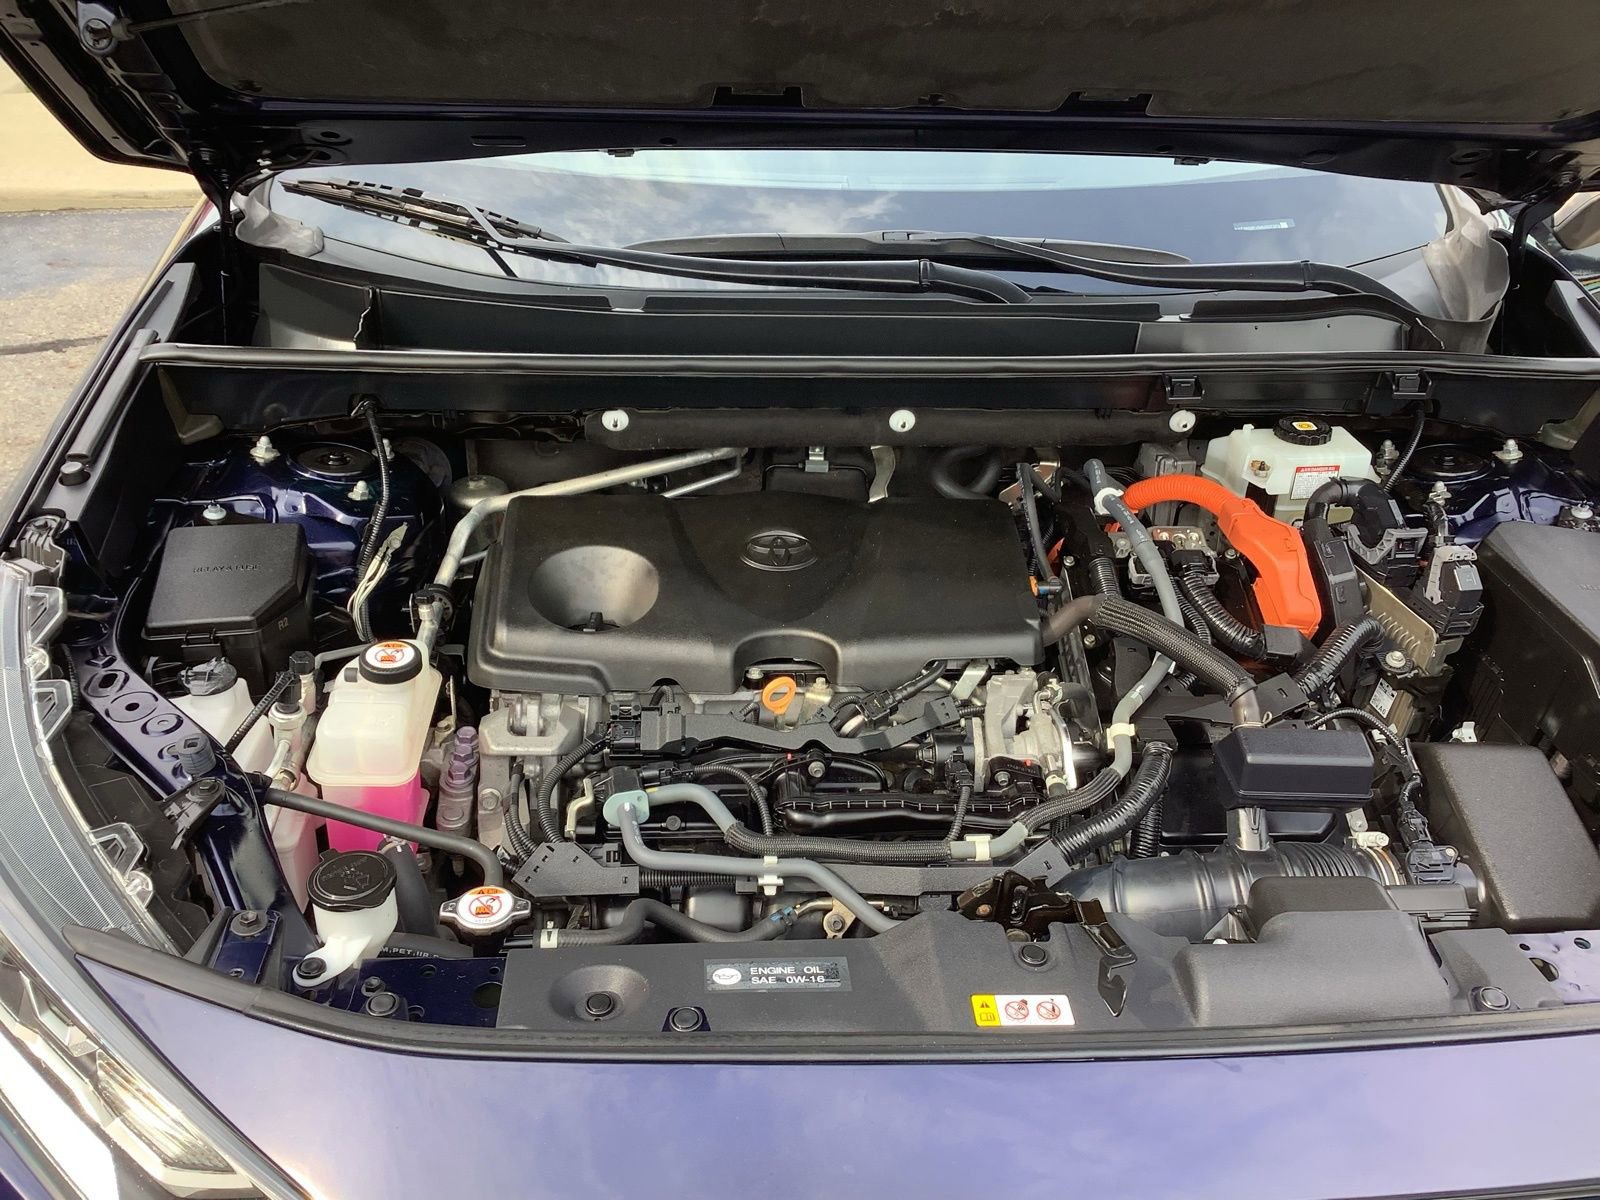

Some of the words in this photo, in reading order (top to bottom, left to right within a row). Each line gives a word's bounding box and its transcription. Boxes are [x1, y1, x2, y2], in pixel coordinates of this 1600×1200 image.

[750, 966, 796, 975] ENGINE
[803, 965, 825, 974] OIL
[751, 976, 777, 985] SAE
[785, 975, 825, 984] 0W-16
